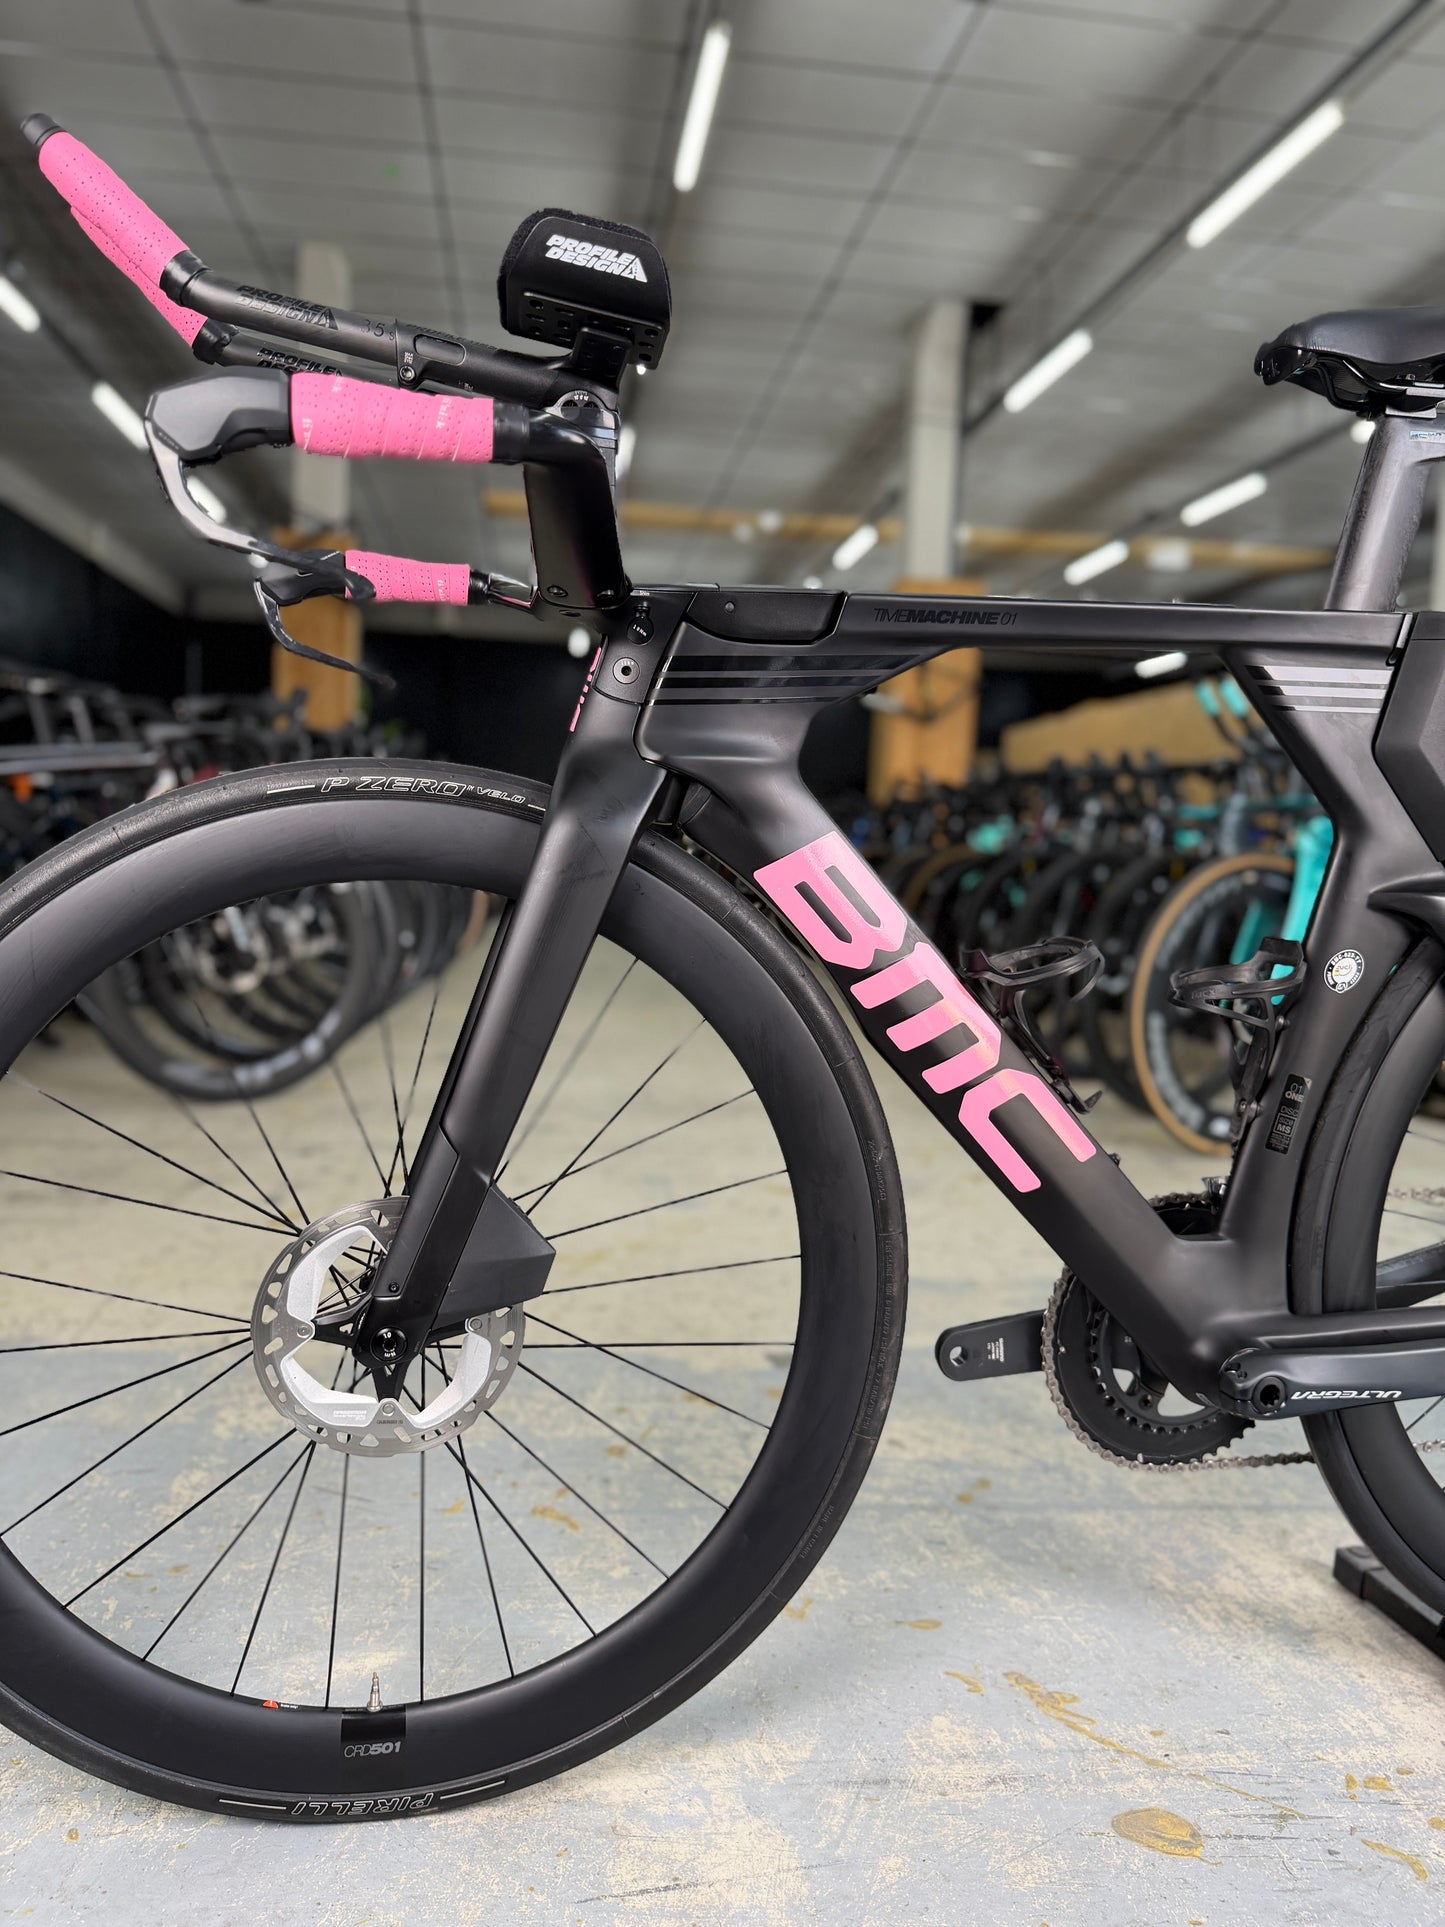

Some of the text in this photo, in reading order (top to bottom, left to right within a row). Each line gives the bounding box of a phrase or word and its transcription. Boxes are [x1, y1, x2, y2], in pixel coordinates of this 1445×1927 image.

[546, 234, 636, 265] PROFILE
[545, 246, 626, 276] DESIGN
[236, 285, 328, 312] PROFILE
[235, 293, 319, 325] DESIGN
[256, 348, 337, 375] PROFILE
[874, 608, 1001, 625] TIMEMACHINE
[321, 776, 350, 793] P
[355, 776, 467, 797] ZERO
[476, 786, 526, 804] VELO
[753, 831, 1097, 1193] BMC
[1285, 1091, 1305, 1103] ONE
[1290, 1082, 1304, 1095] 01
[1281, 1105, 1299, 1117] DISC
[1276, 1124, 1292, 1134] MS
[383, 1331, 392, 1339] 10
[1291, 1390, 1402, 1400] ULTEGRA
[344, 1741, 402, 1758] CRD501
[291, 1793, 434, 1816] PIRELLI
